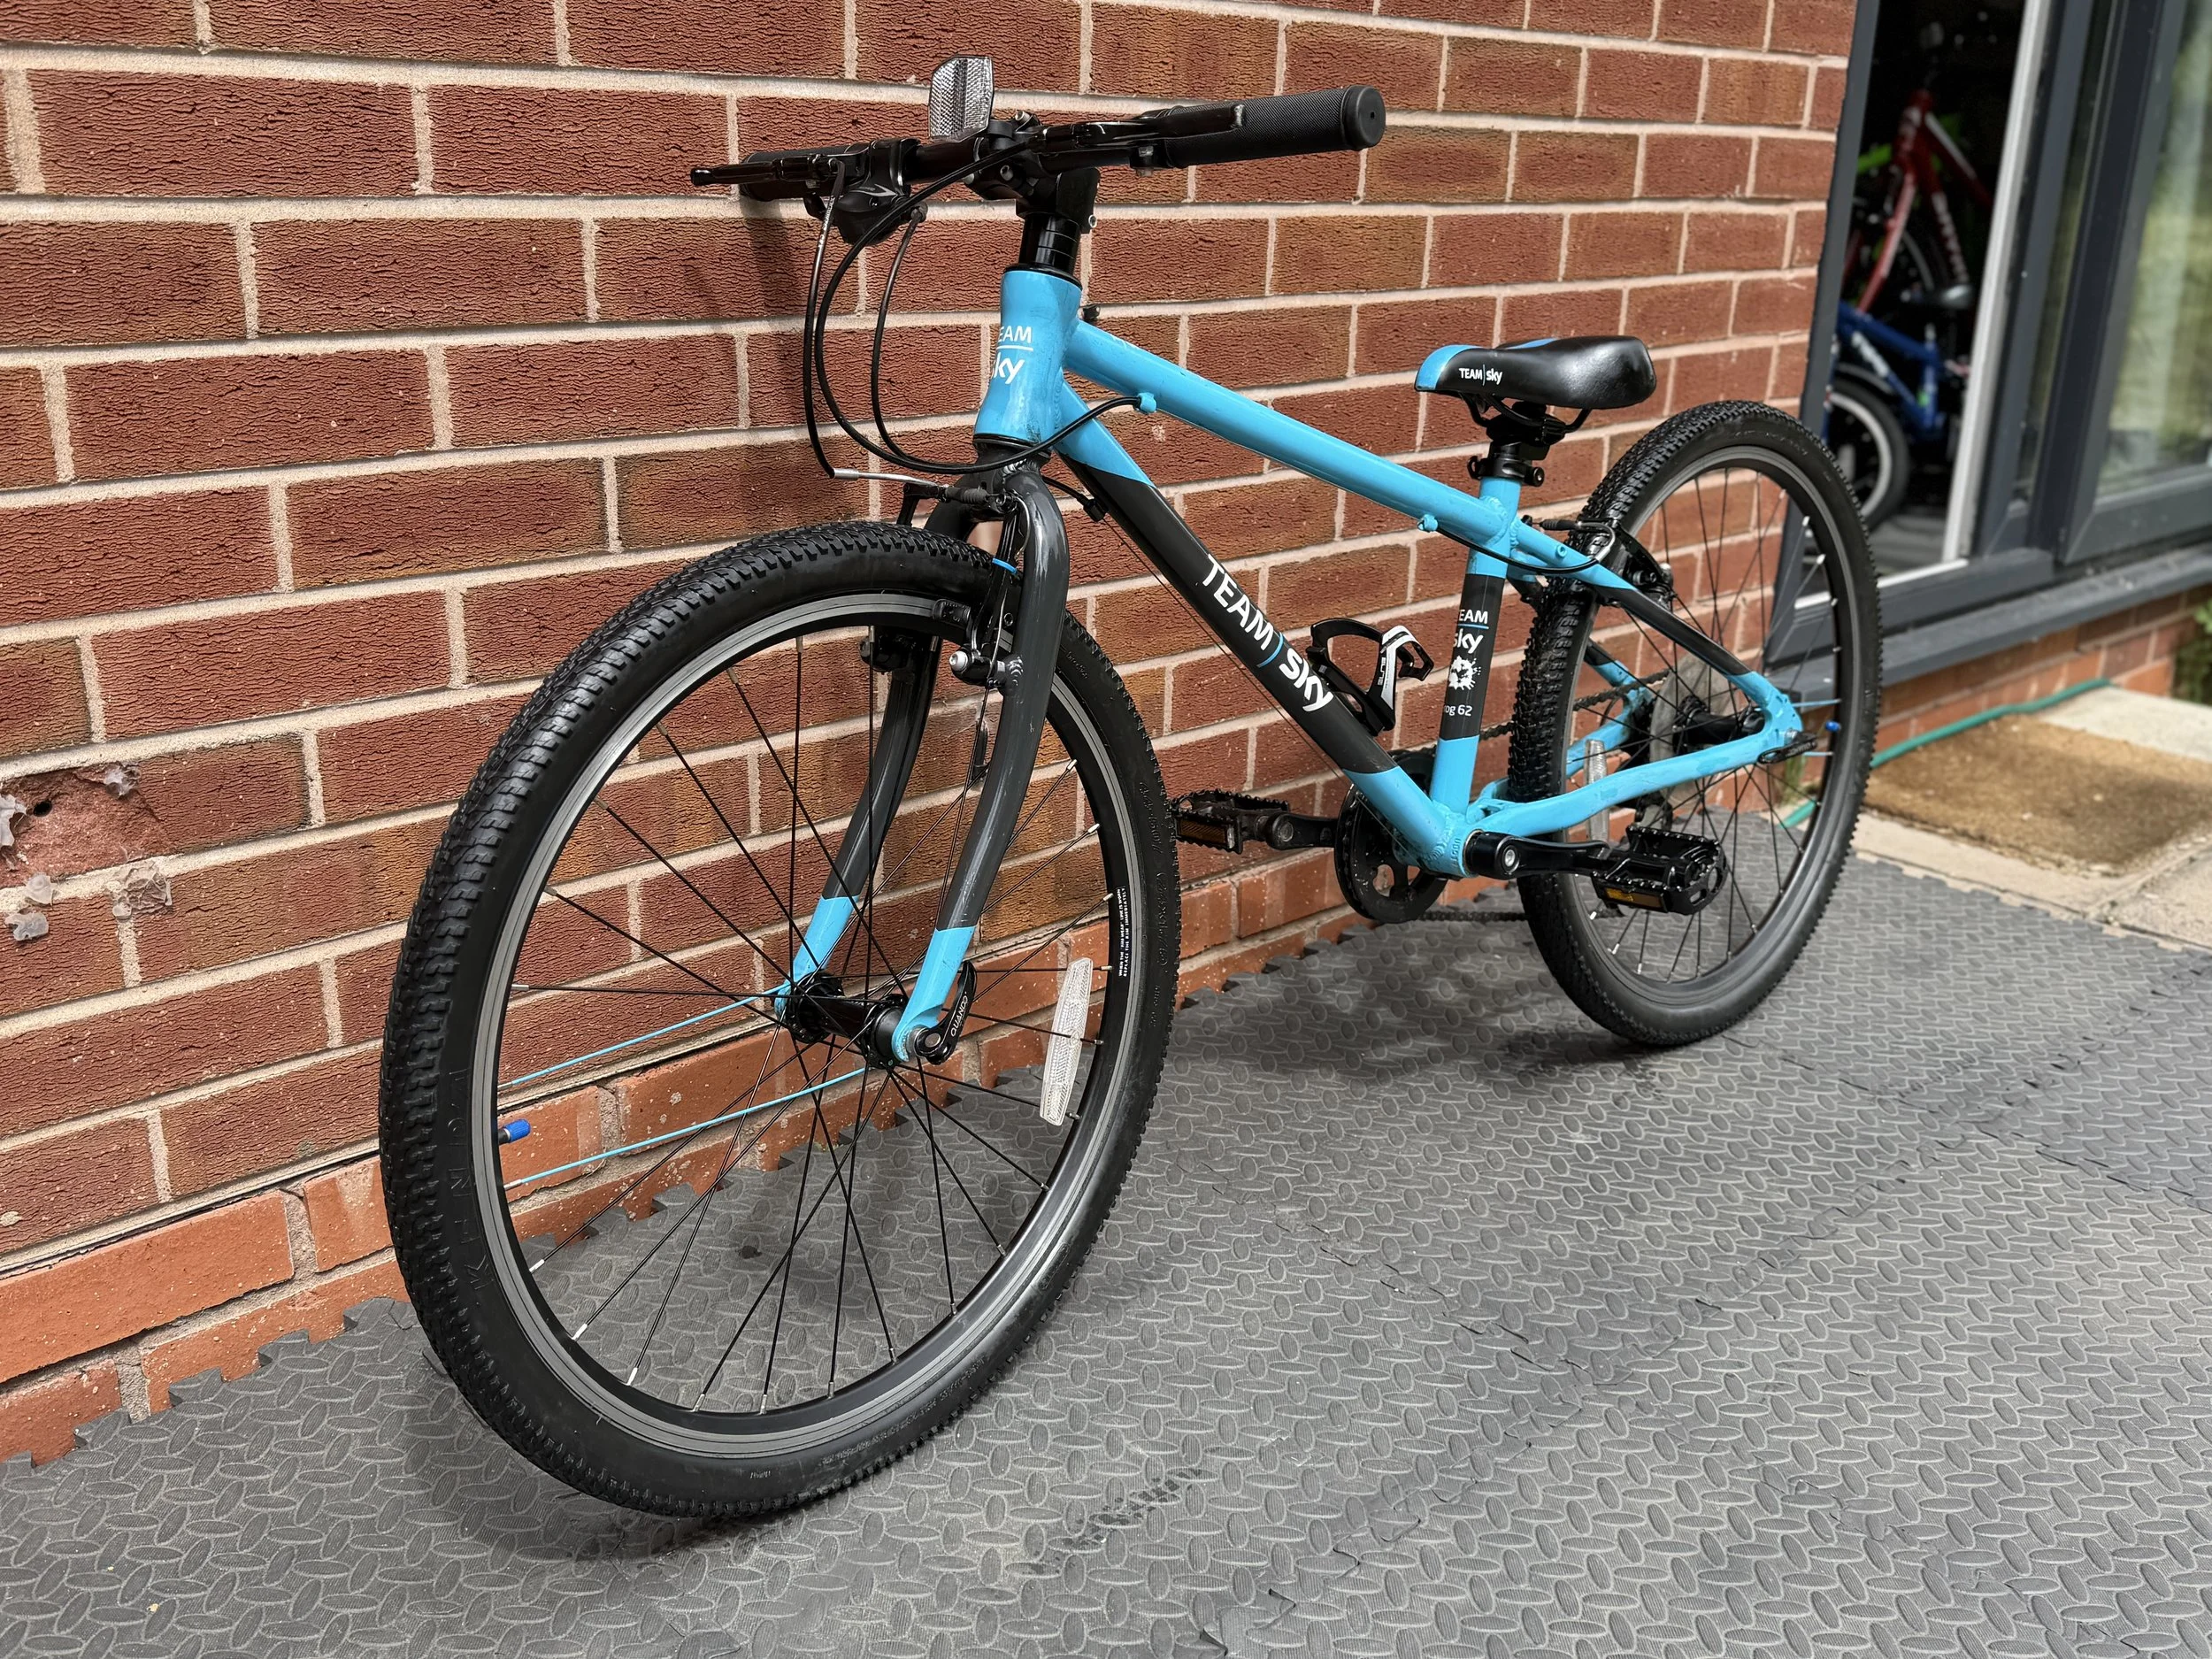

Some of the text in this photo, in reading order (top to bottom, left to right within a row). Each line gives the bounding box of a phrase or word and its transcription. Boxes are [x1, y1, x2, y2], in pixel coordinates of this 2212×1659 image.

[998, 325, 1032, 343] EAM
[991, 351, 1025, 385] ky
[1458, 367, 1503, 386] TEAM sky
[1202, 553, 1274, 651] TEAM
[1458, 609, 1488, 625] EAM
[1457, 704, 1473, 717] 62
[950, 995, 969, 1037] QUANDO
